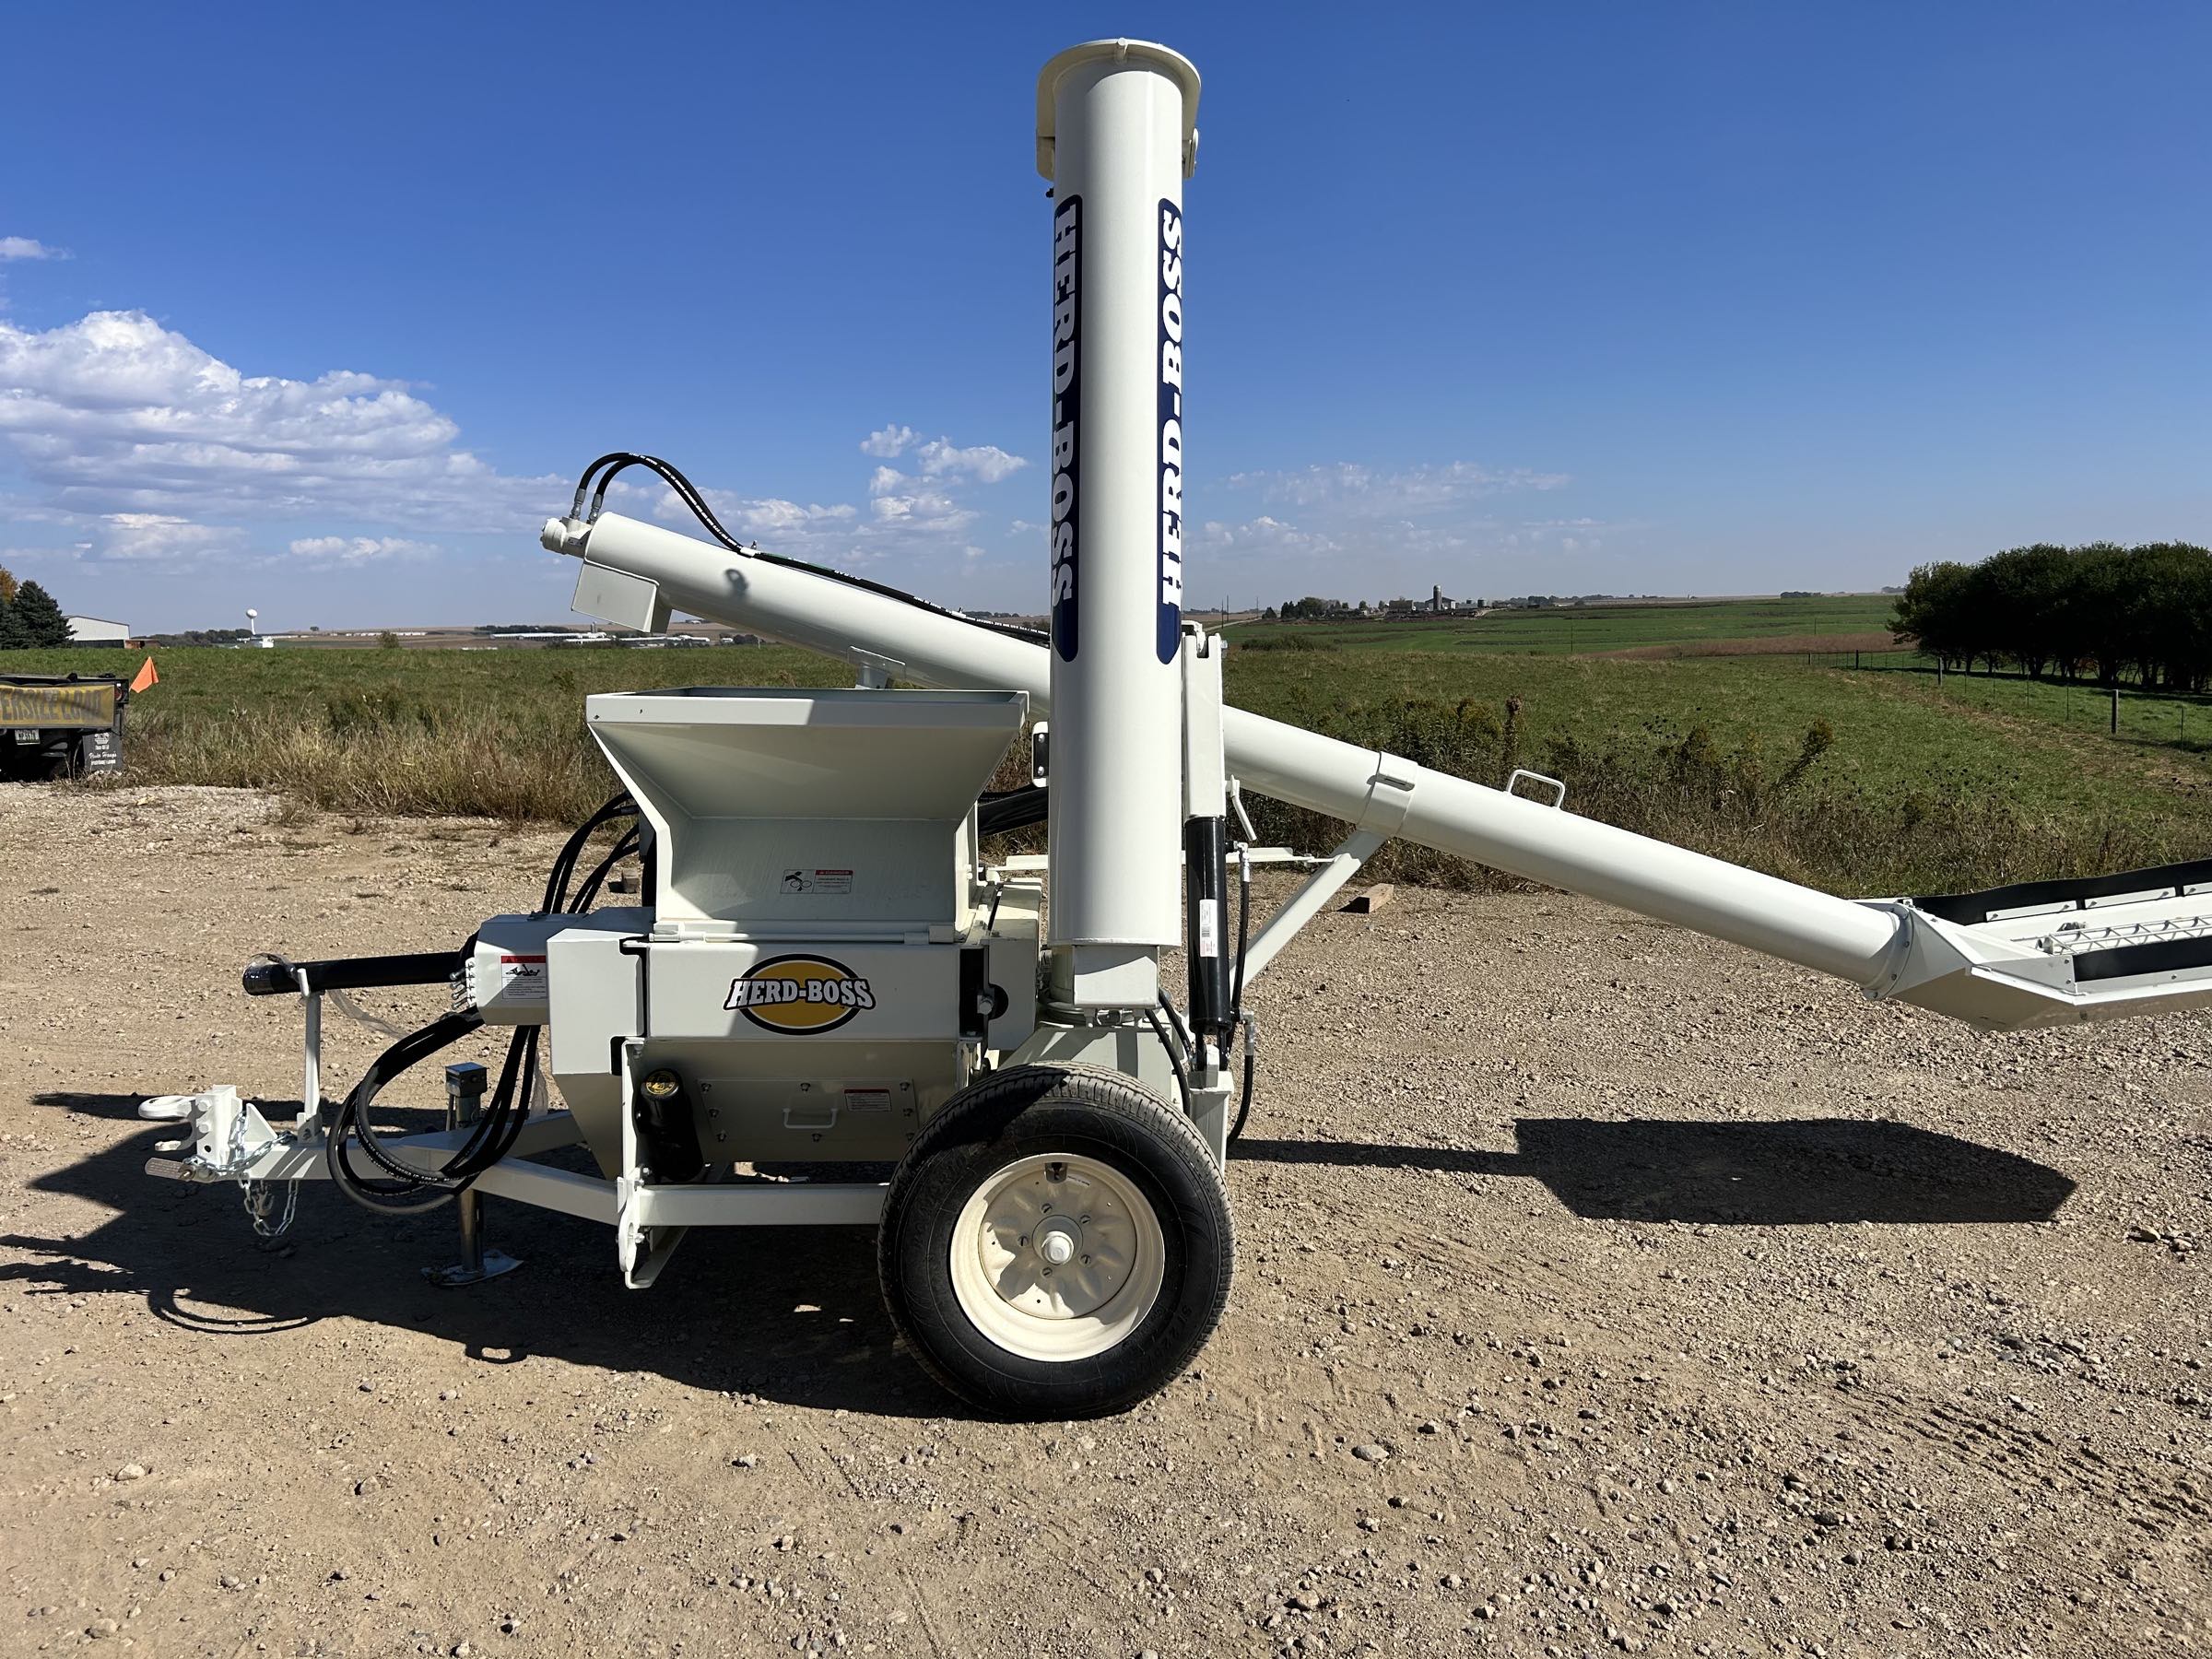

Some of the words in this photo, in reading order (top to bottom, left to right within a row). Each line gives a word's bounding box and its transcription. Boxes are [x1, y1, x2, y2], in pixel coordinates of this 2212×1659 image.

[1052, 204, 1077, 607] HERD-BOSS
[1162, 209, 1182, 612] HERD-BOSS
[724, 980, 875, 1008] HERD-BOSS
